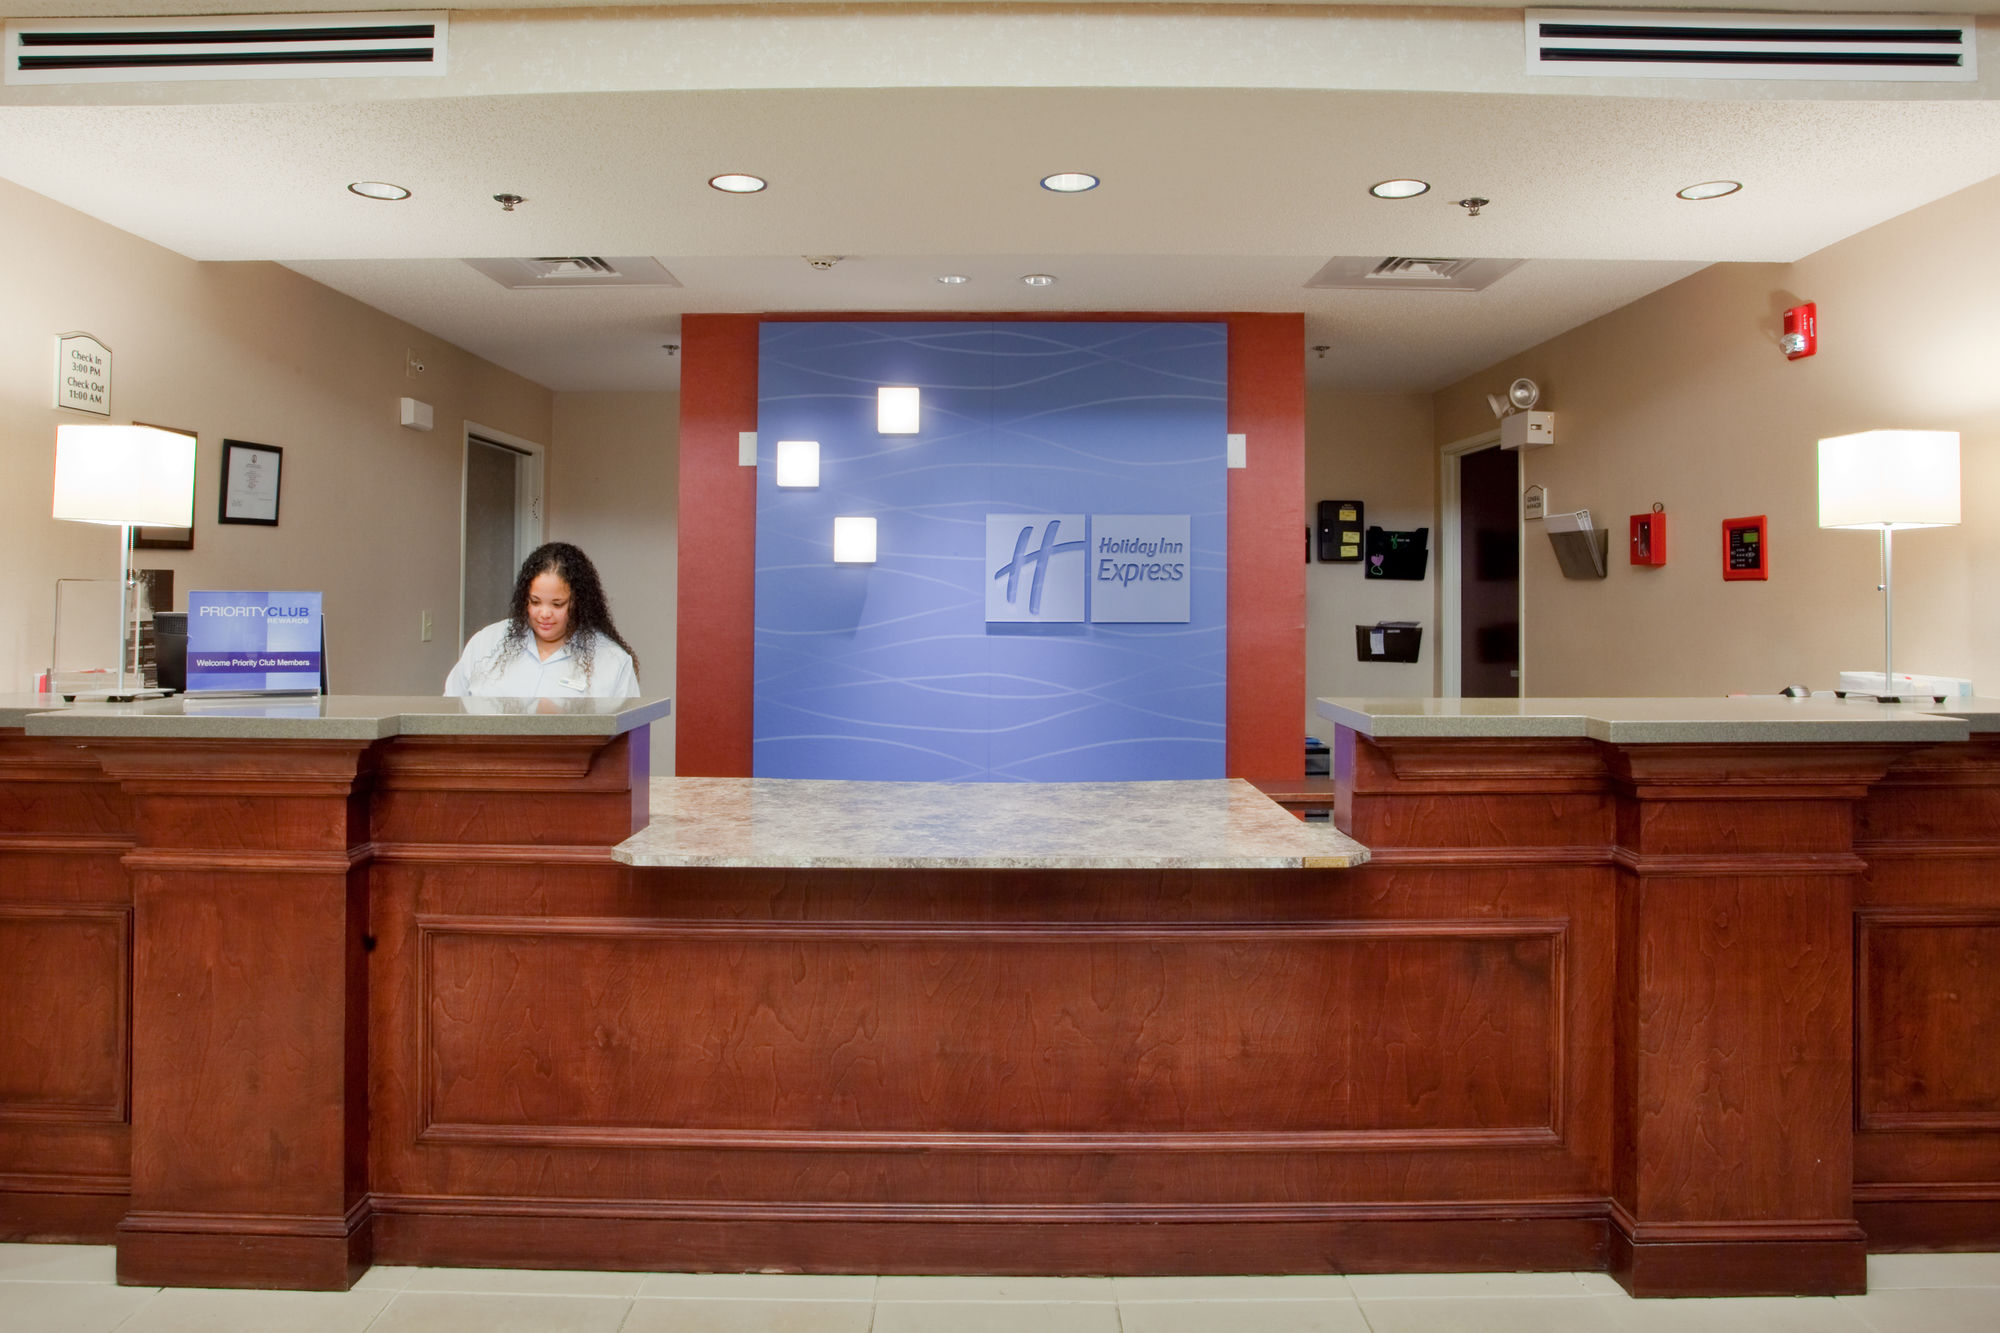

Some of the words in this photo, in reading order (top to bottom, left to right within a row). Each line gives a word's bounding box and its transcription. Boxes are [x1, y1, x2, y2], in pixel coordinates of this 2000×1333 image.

[71, 350, 93, 363] Check
[95, 356, 102, 365] In
[72, 362, 87, 373] 3:00
[90, 366, 101, 376] PM
[67, 376, 89, 389] Check
[91, 382, 104, 393] Out
[69, 389, 88, 400] 11:00
[90, 393, 102, 403] AM
[1099, 537, 1158, 557] Holiday
[1159, 537, 1184, 554] Inn
[1097, 558, 1185, 588] Express
[196, 659, 231, 667] Welcome
[232, 659, 258, 668] Priority
